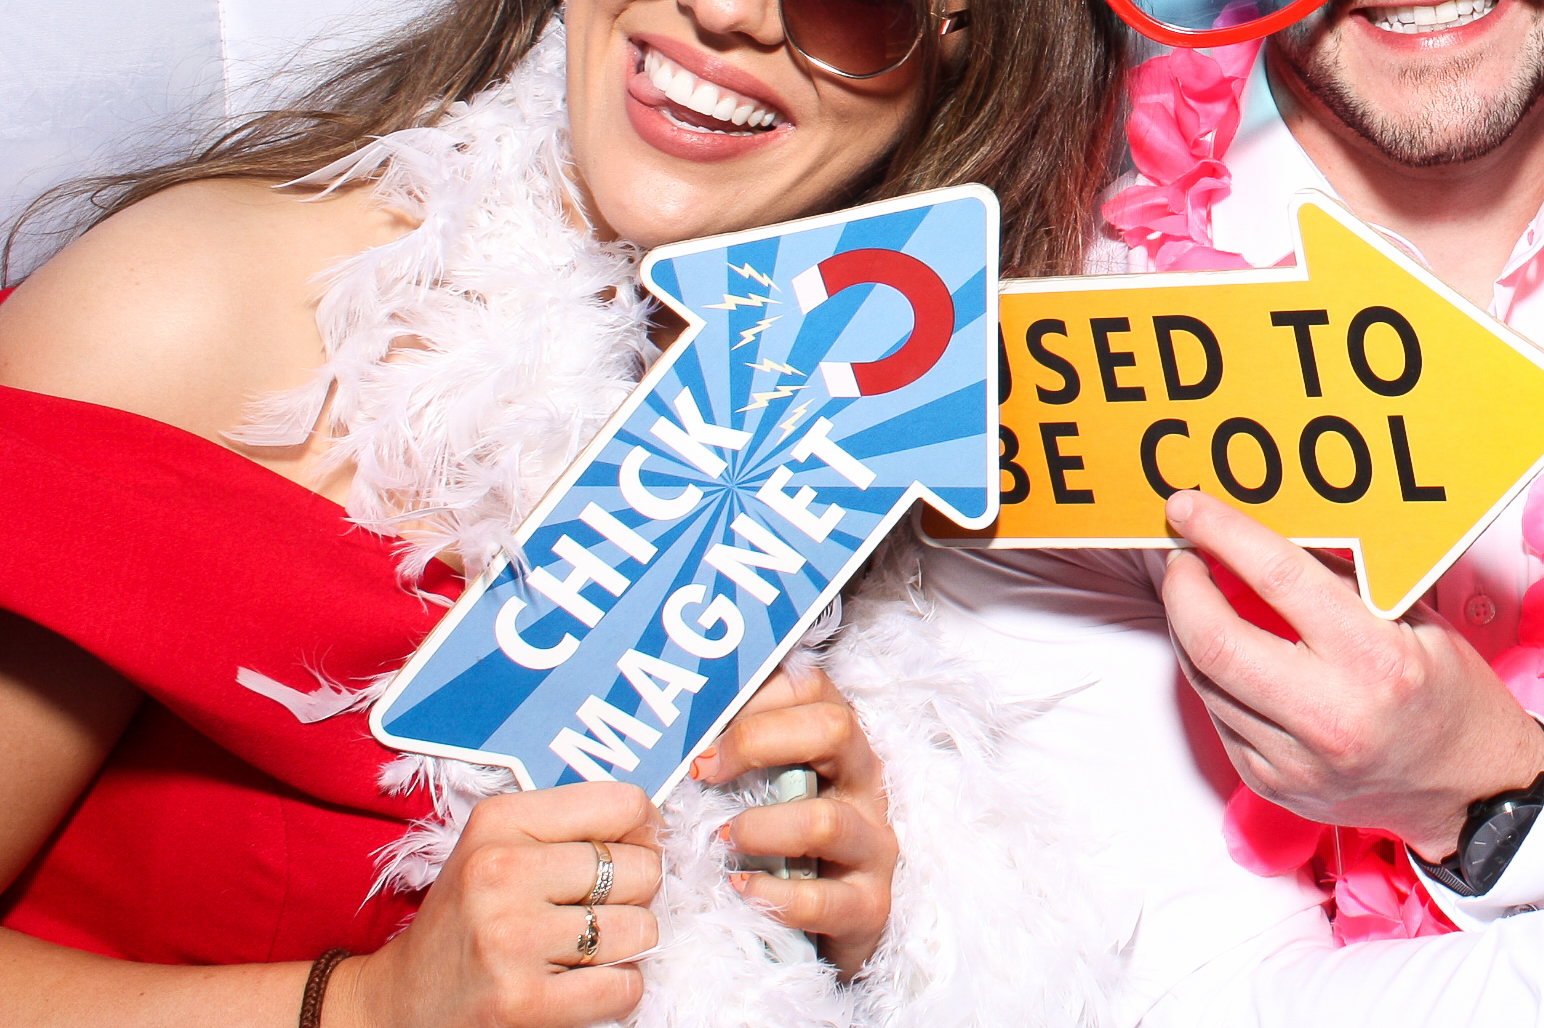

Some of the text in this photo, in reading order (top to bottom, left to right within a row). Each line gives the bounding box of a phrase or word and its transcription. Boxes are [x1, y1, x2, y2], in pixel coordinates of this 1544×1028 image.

[1270, 306, 1423, 397] TO
[494, 386, 752, 670] CHICK
[1140, 415, 1447, 505] COOL
[548, 415, 877, 783] MAGNET
